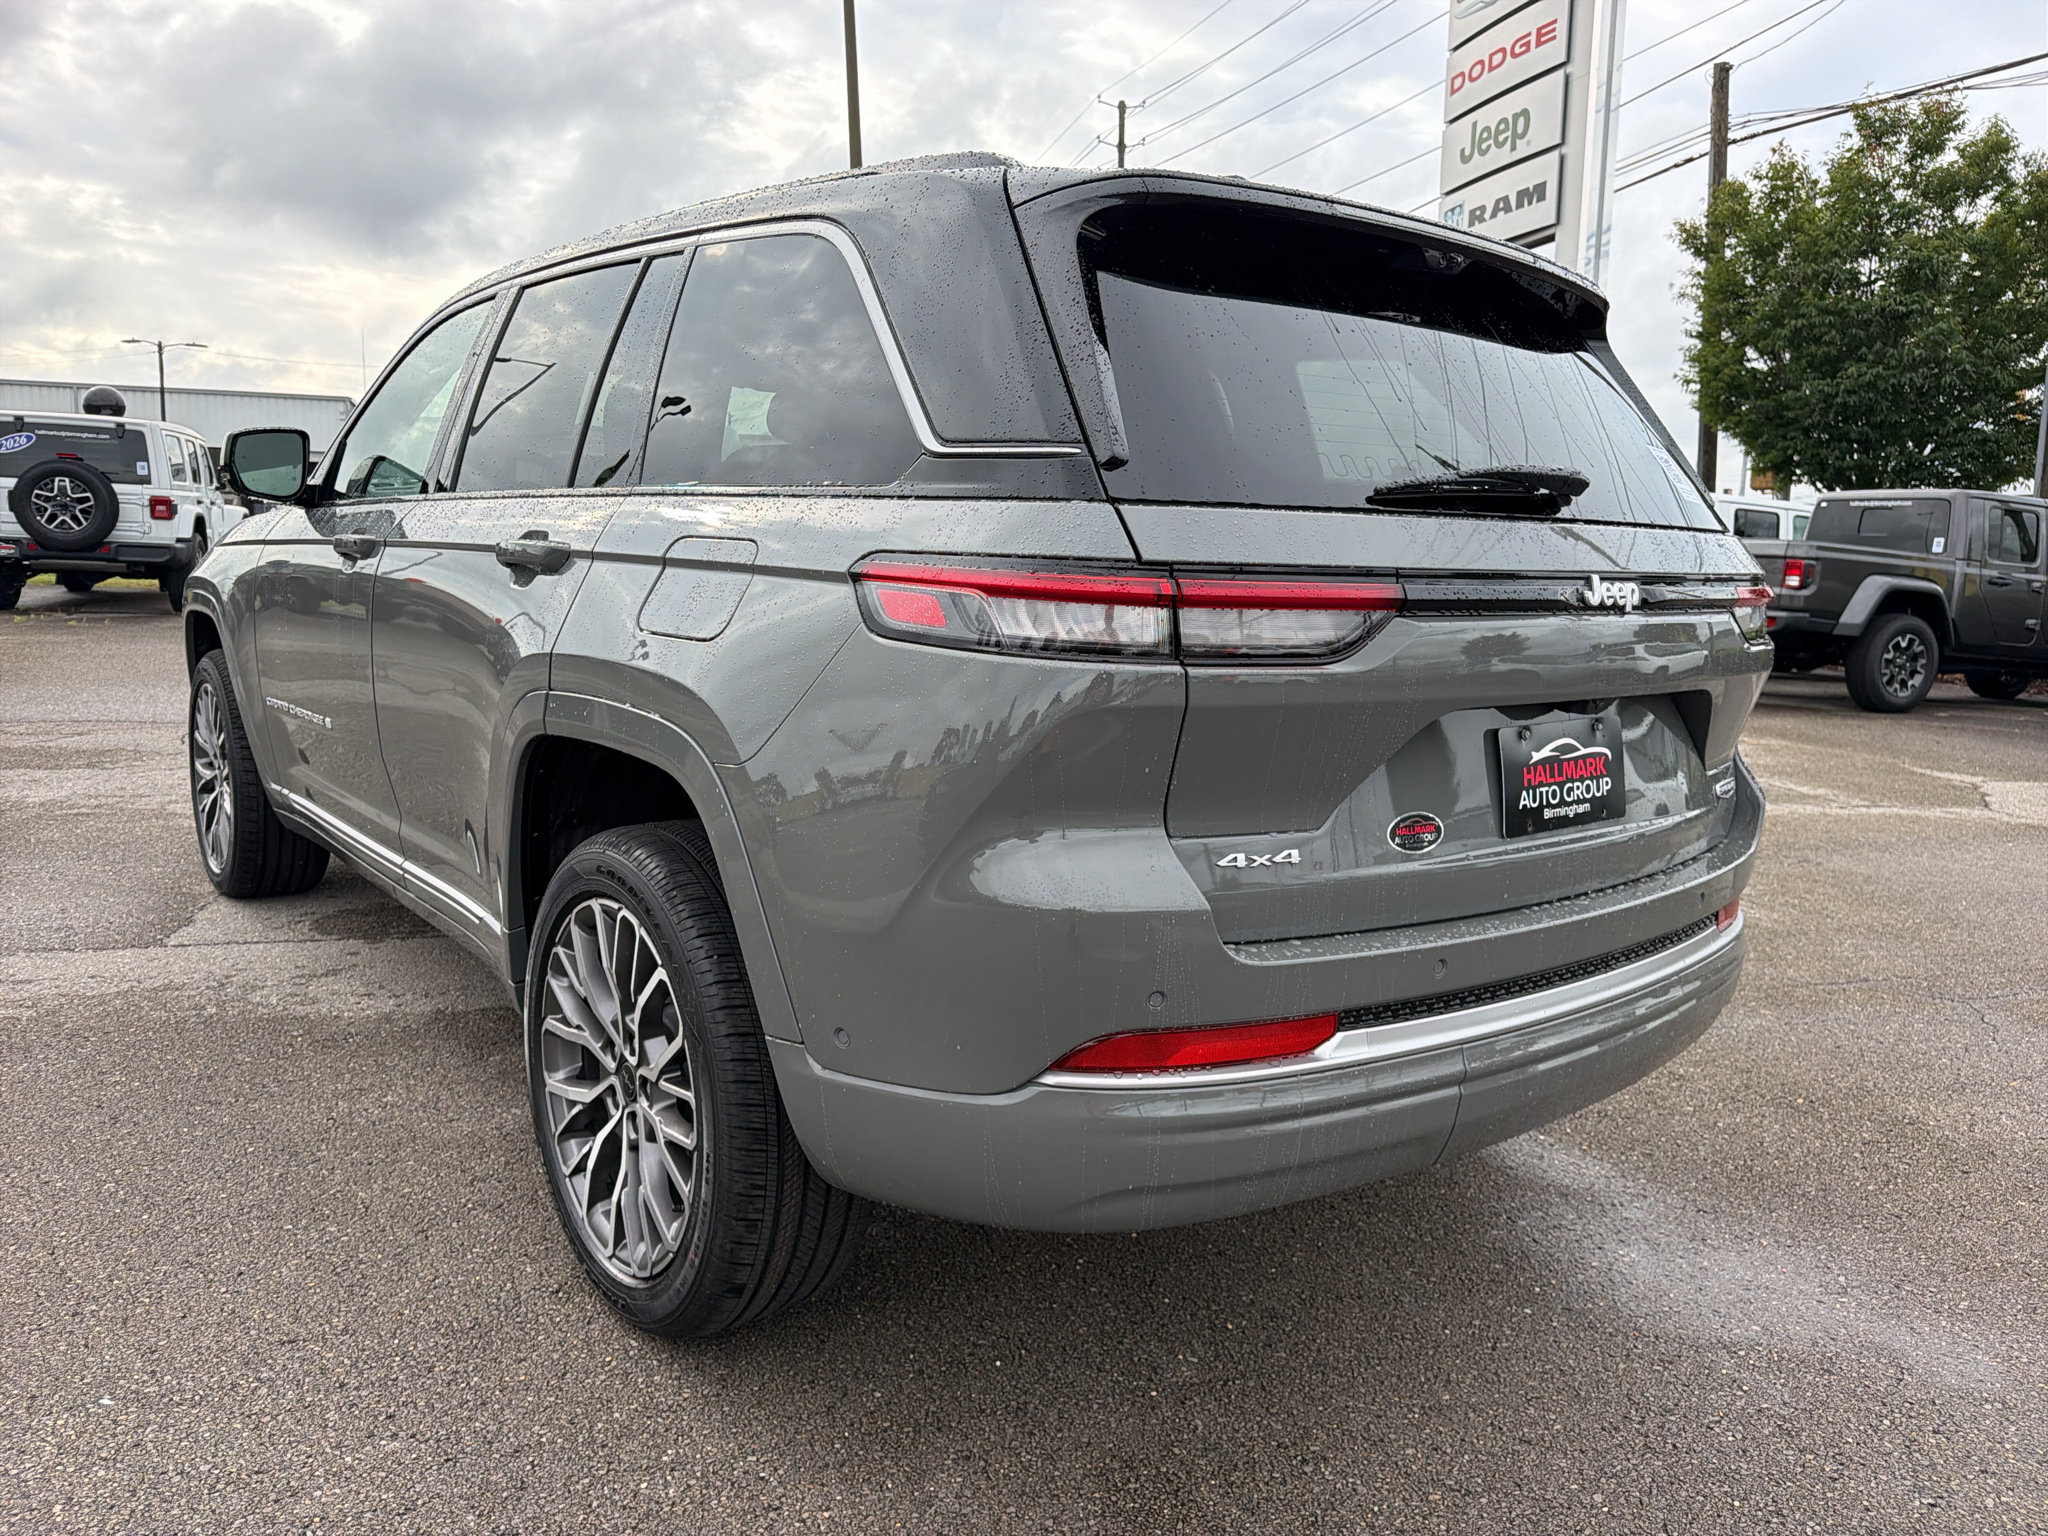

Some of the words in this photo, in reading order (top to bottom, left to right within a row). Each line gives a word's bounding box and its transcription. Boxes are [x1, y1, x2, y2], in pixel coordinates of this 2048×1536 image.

[1449, 18, 1558, 97] DODGE
[1459, 107, 1531, 165] Jeep
[1467, 180, 1548, 229] RAM
[0, 435, 27, 451] 2026
[1583, 574, 1640, 613] Jeep
[1522, 755, 1608, 788] HALLMARK
[1518, 784, 1561, 811] AUTO
[1562, 776, 1613, 803] GROUP
[1543, 802, 1592, 820] Birmingham
[1394, 834, 1414, 845] AUTO
[1414, 831, 1440, 843] GROUP
[1395, 824, 1437, 837] HALLMARK
[1215, 848, 1302, 868] 4x4
